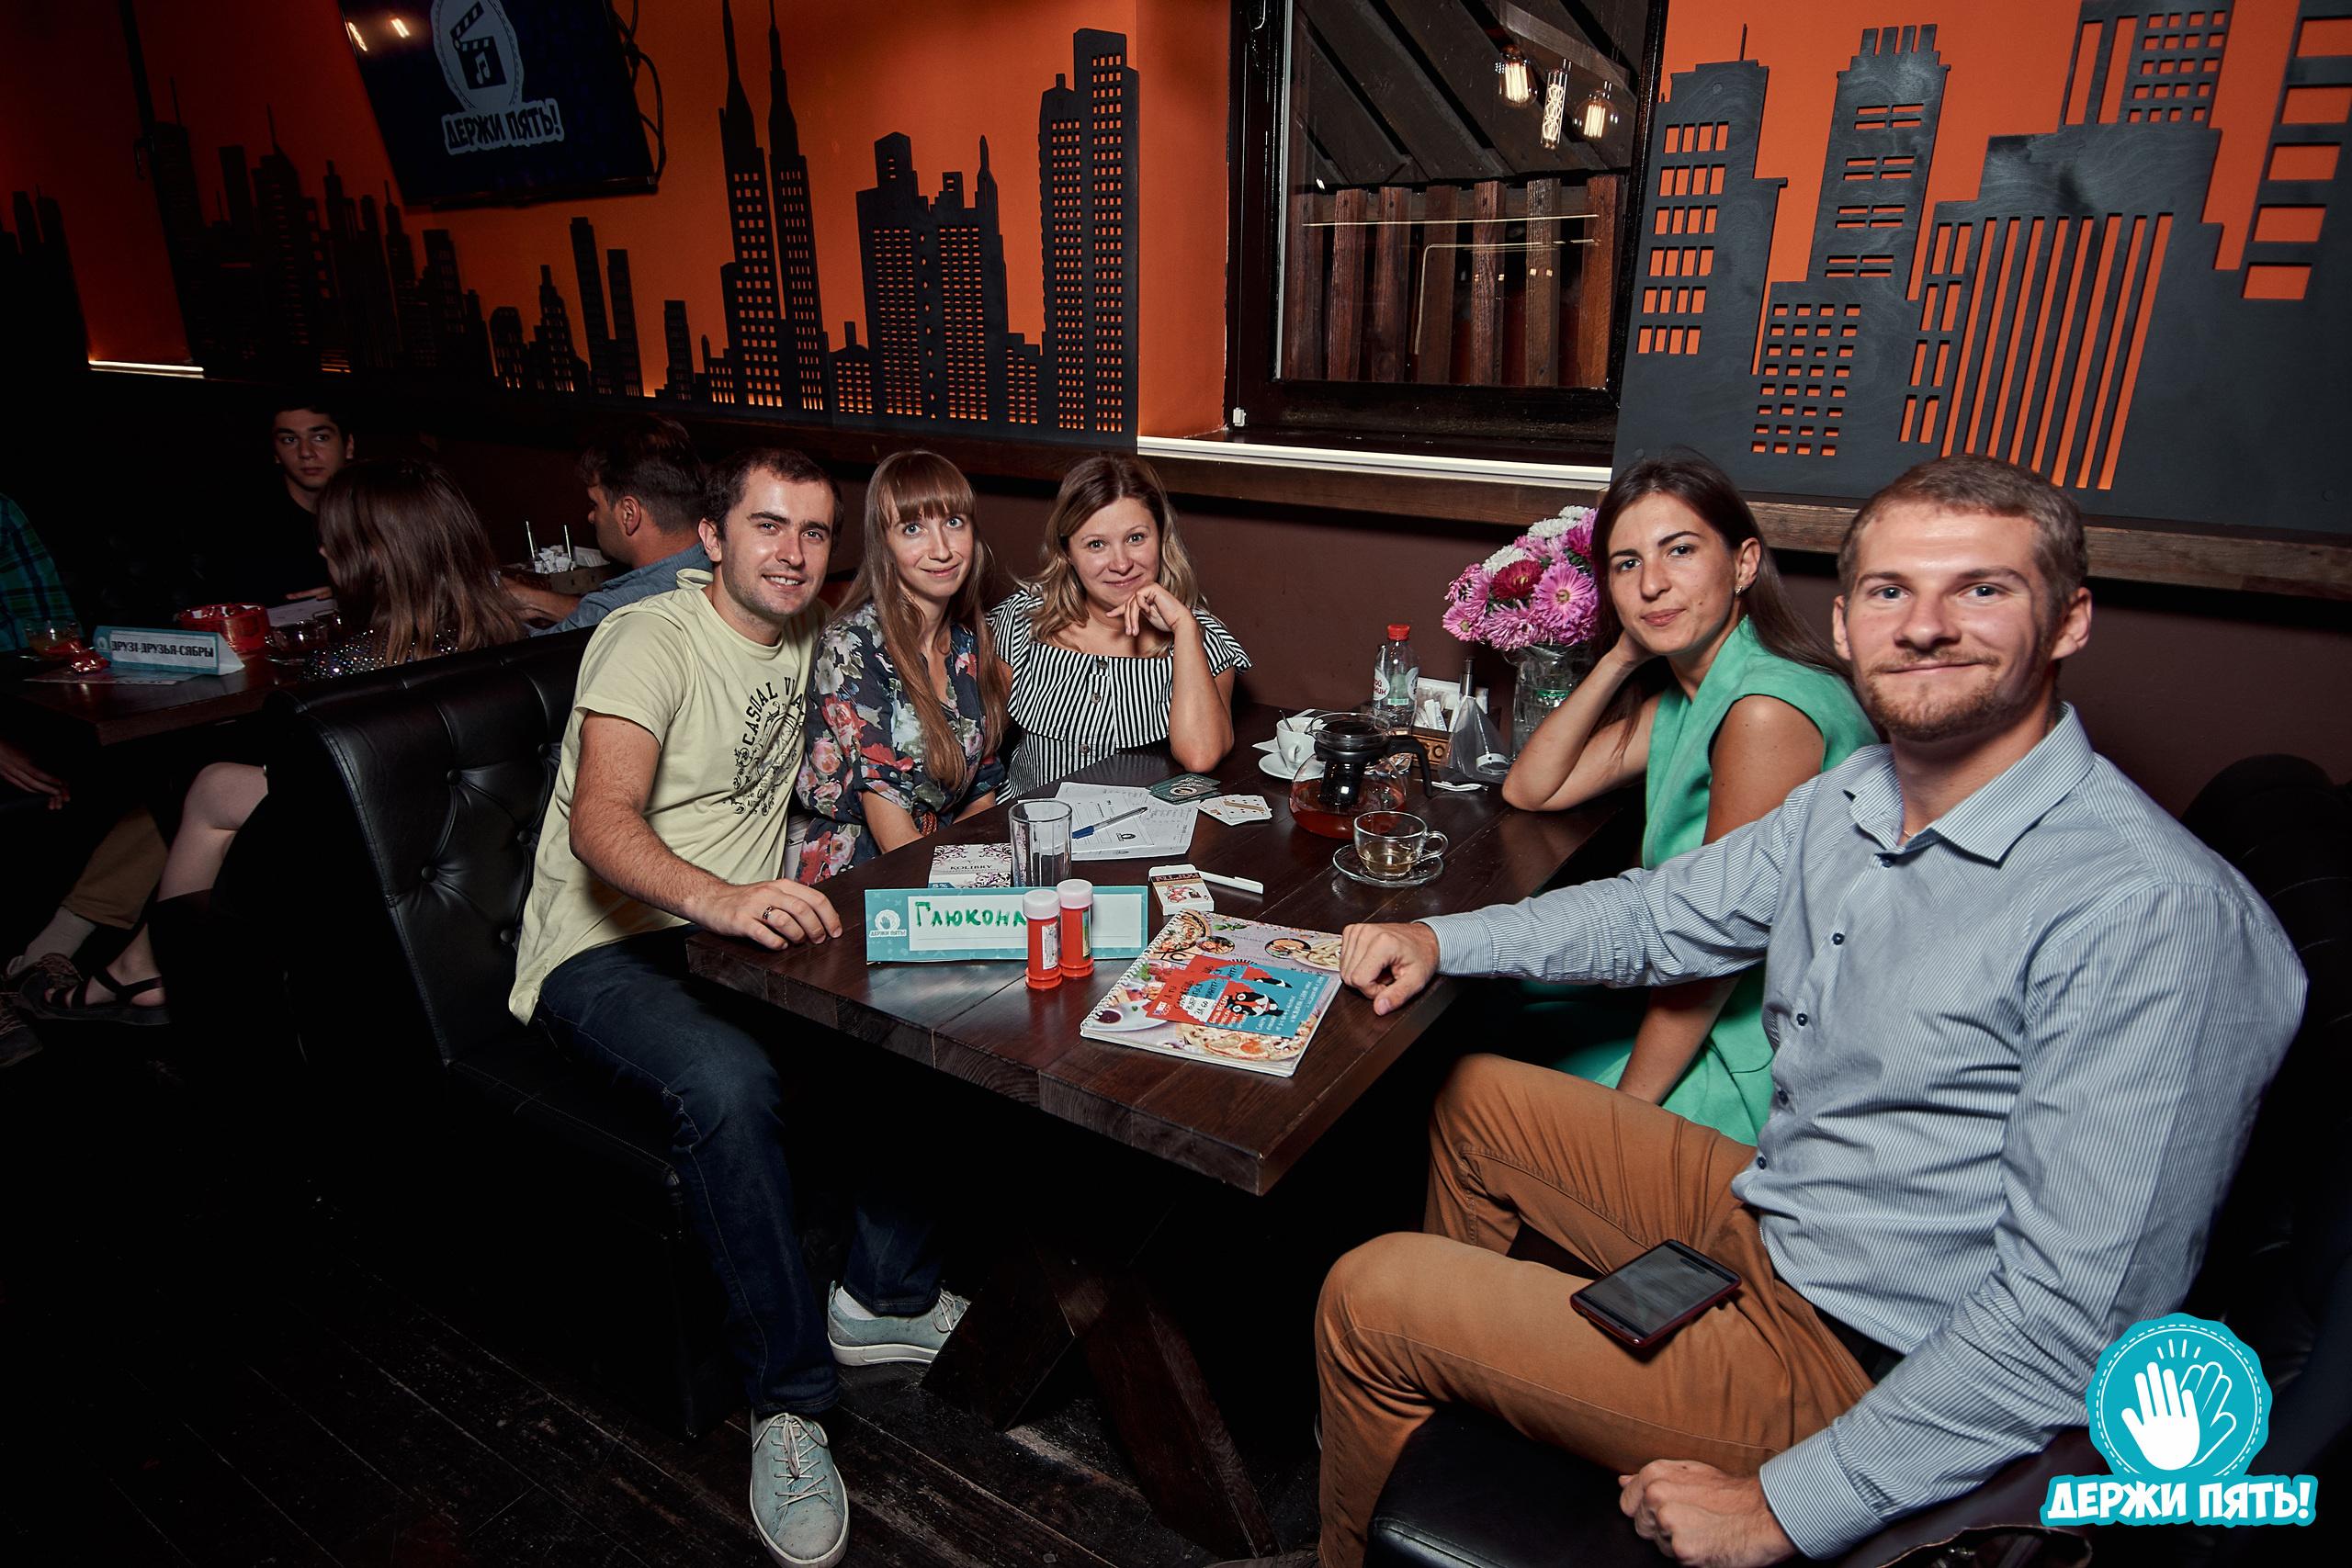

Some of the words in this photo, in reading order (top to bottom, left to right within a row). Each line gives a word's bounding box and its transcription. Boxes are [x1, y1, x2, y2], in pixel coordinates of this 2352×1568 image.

[445, 113, 505, 149] ДЕРЖИ
[506, 105, 560, 140] ПЯТЬ!
[742, 682, 778, 746] CASUAL
